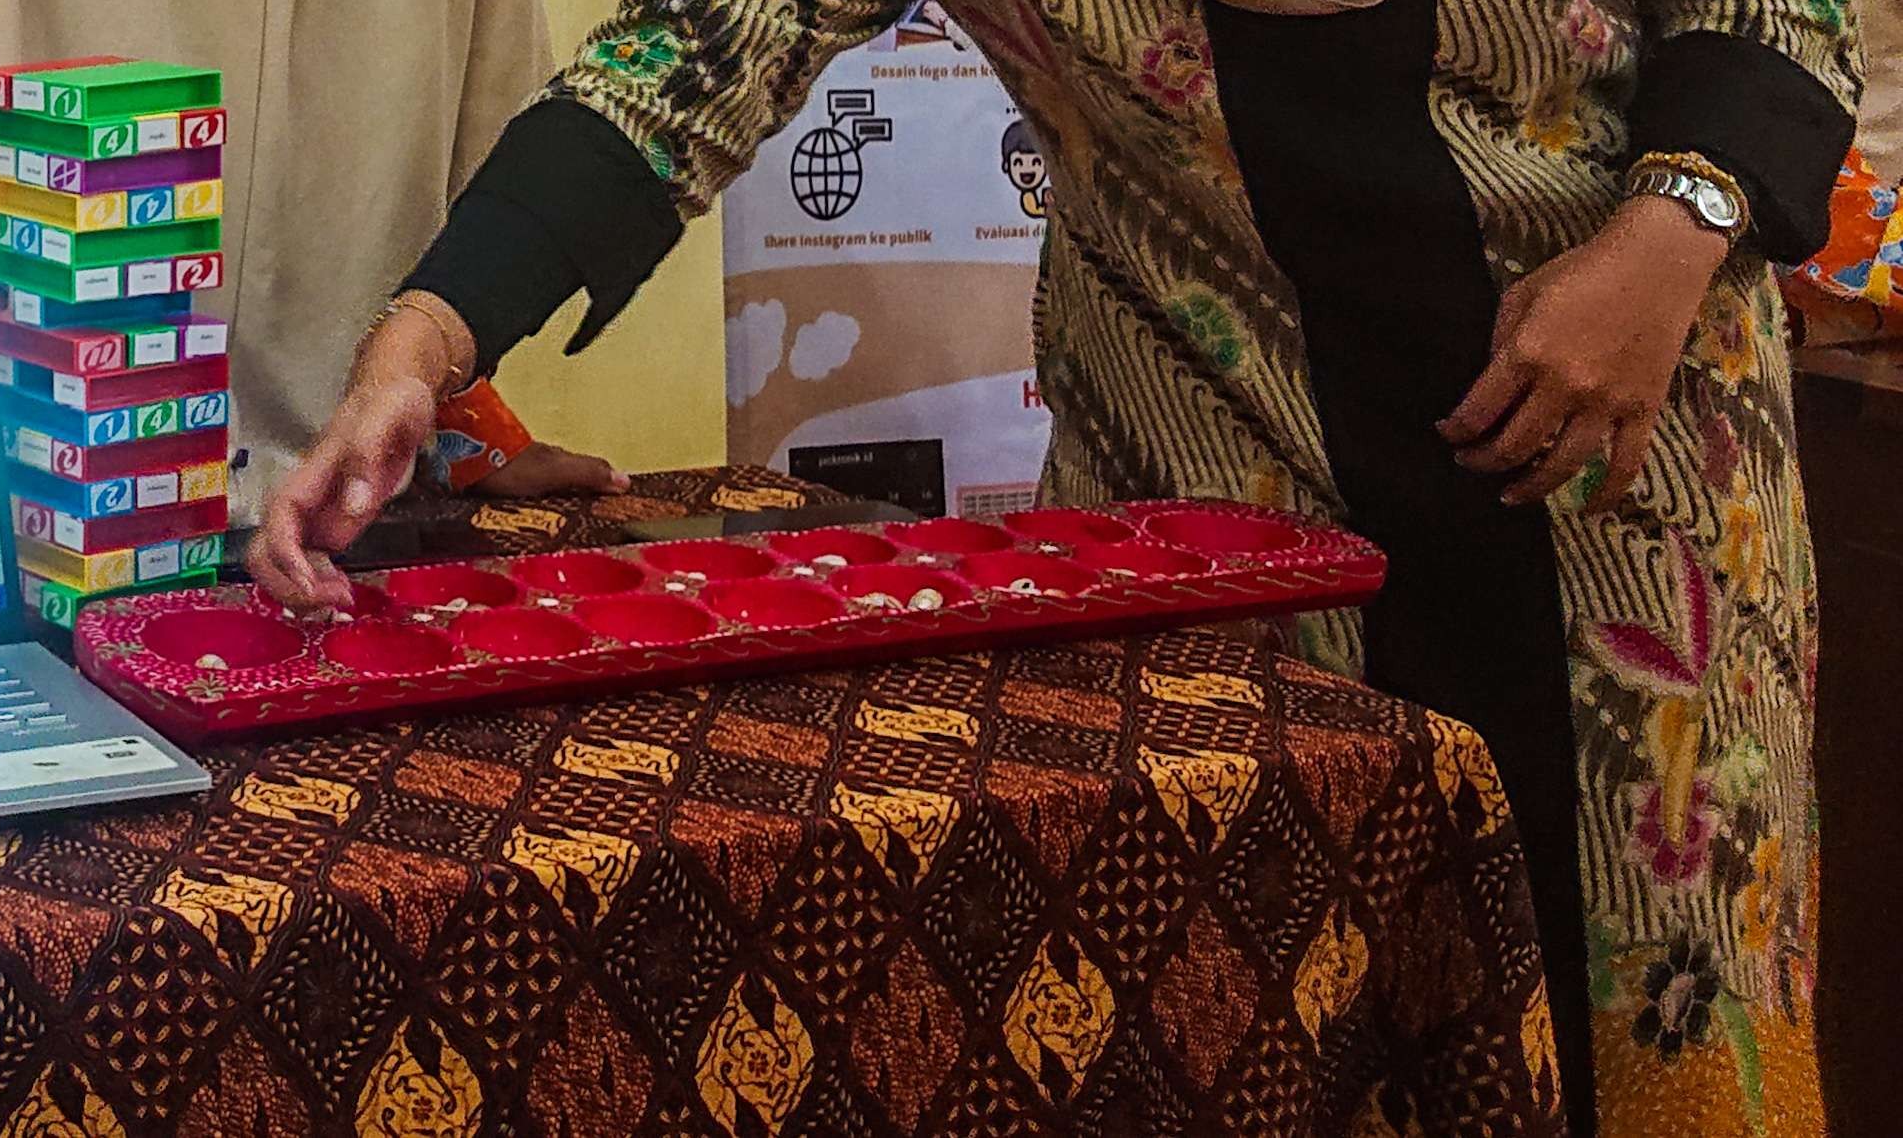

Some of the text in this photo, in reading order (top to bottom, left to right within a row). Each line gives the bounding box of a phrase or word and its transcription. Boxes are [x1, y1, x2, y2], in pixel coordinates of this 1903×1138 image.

[919, 64, 949, 81] logo
[952, 64, 978, 78] dan
[869, 231, 886, 245] ke
[889, 230, 933, 248] publik
